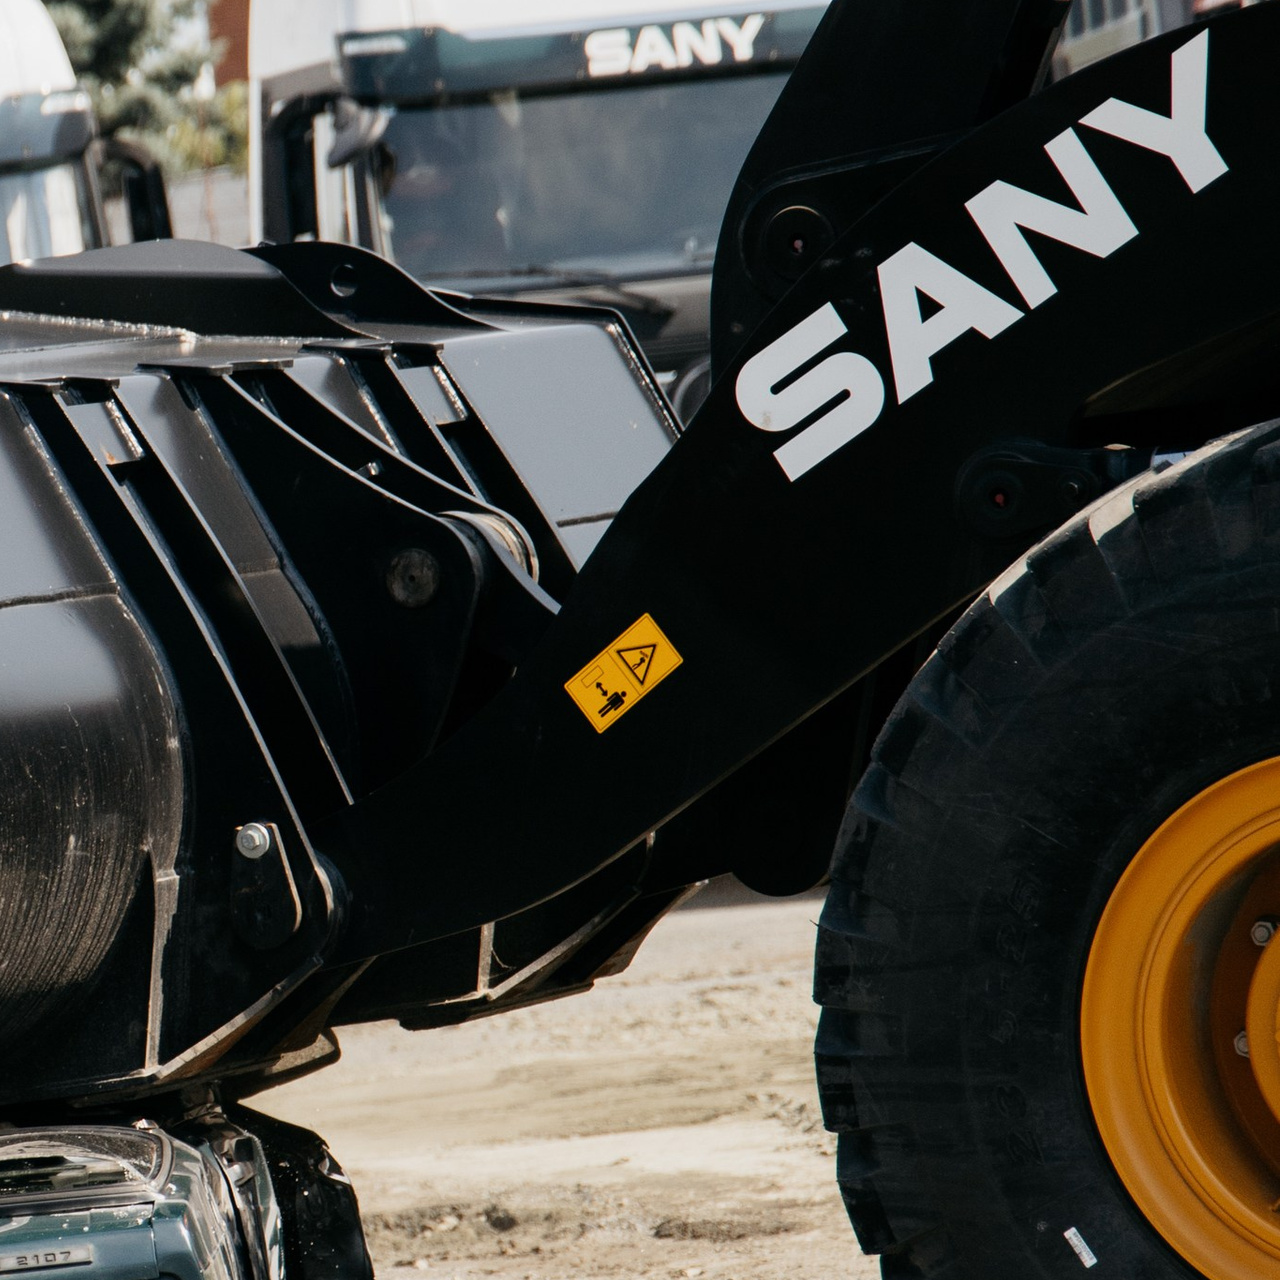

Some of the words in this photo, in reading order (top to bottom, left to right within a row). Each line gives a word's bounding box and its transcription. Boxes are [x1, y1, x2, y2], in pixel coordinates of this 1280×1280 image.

[584, 13, 765, 77] SANY
[735, 28, 1229, 482] SANY
[16, 1251, 72, 1266] 2107
